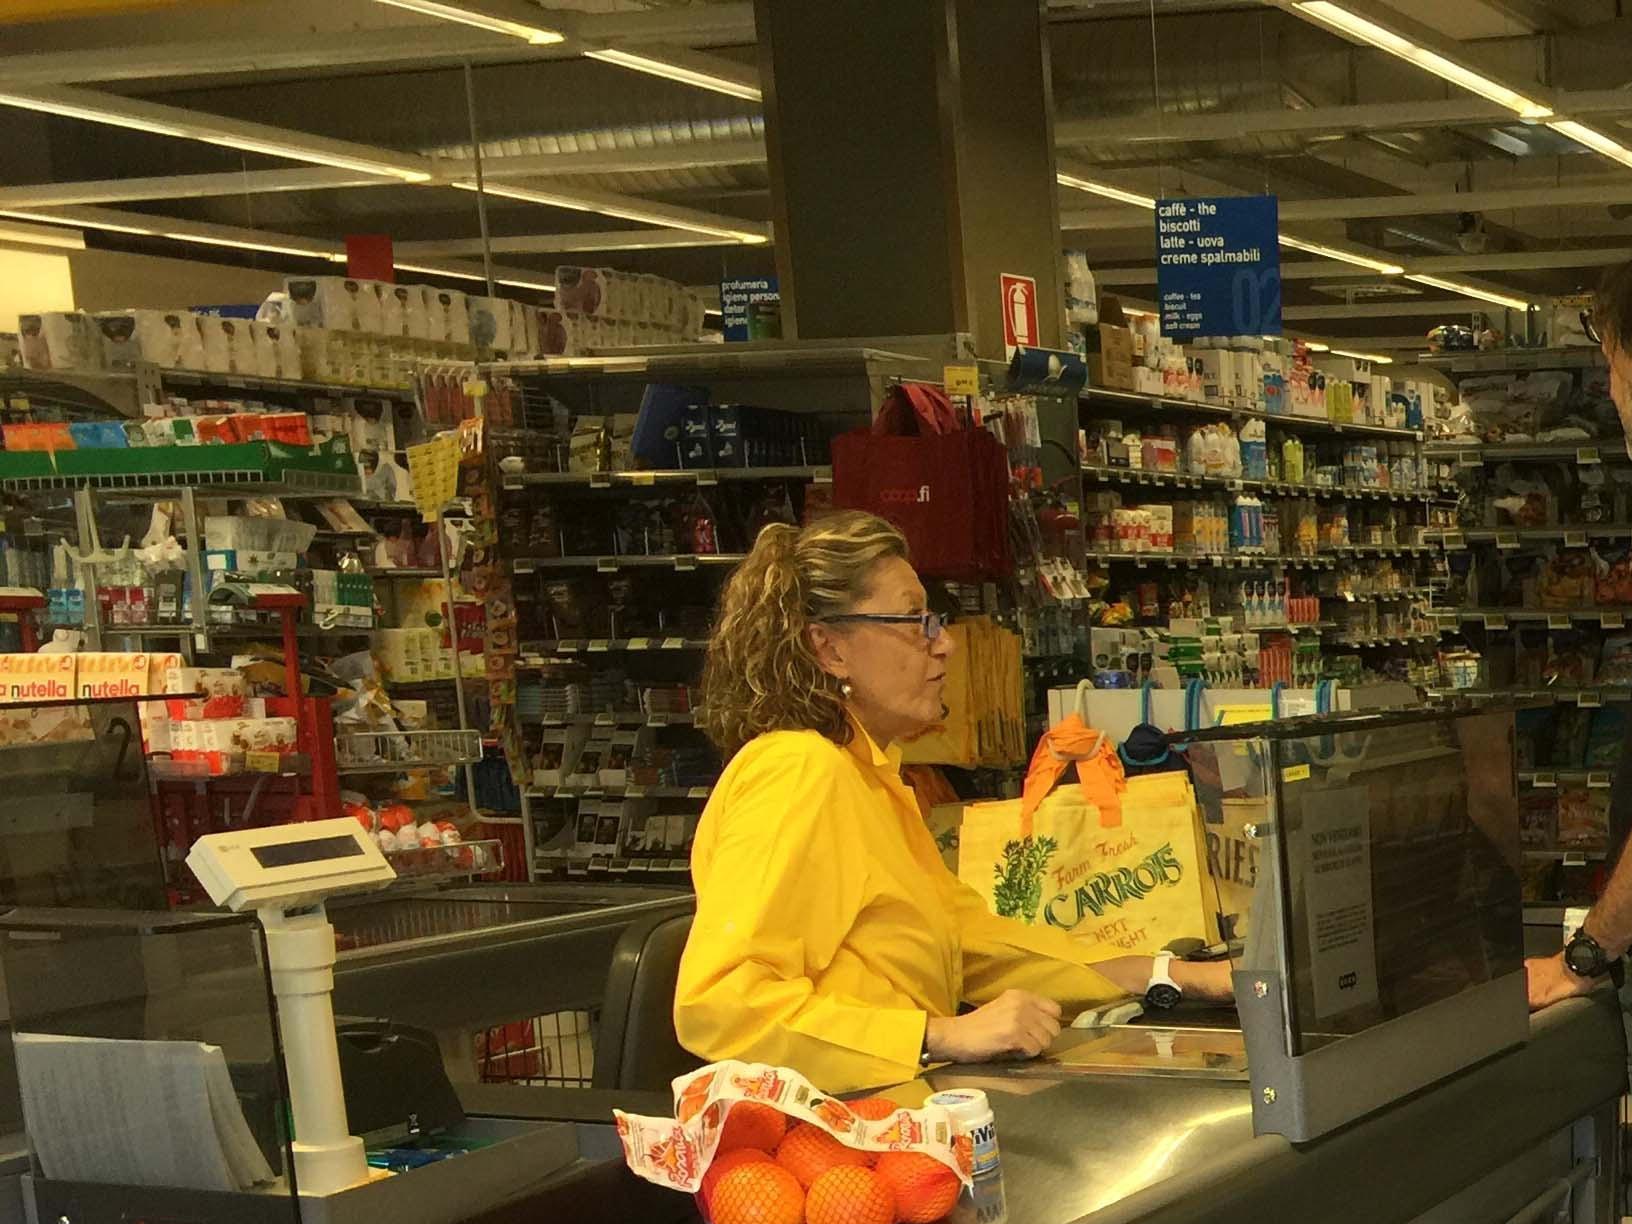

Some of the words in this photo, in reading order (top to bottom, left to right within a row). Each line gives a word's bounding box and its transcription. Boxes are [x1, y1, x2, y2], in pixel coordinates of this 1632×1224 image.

[1158, 203, 1186, 216] caffè
[1198, 202, 1216, 216] the
[1159, 218, 1200, 232] biscotti
[1160, 236, 1185, 248] latte
[1197, 236, 1224, 248] uova
[1161, 253, 1198, 264] creme
[1200, 248, 1260, 266] spalmabili
[722, 280, 768, 292] profumeria
[723, 291, 748, 304] igiene
[724, 304, 744, 314] deter
[11, 679, 67, 698] nutella
[82, 679, 140, 698] nutella
[1051, 860, 1091, 890] Farm
[1095, 834, 1138, 857] Fresh
[1044, 842, 1183, 931] CARROTS
[1107, 927, 1148, 950] IGHT
